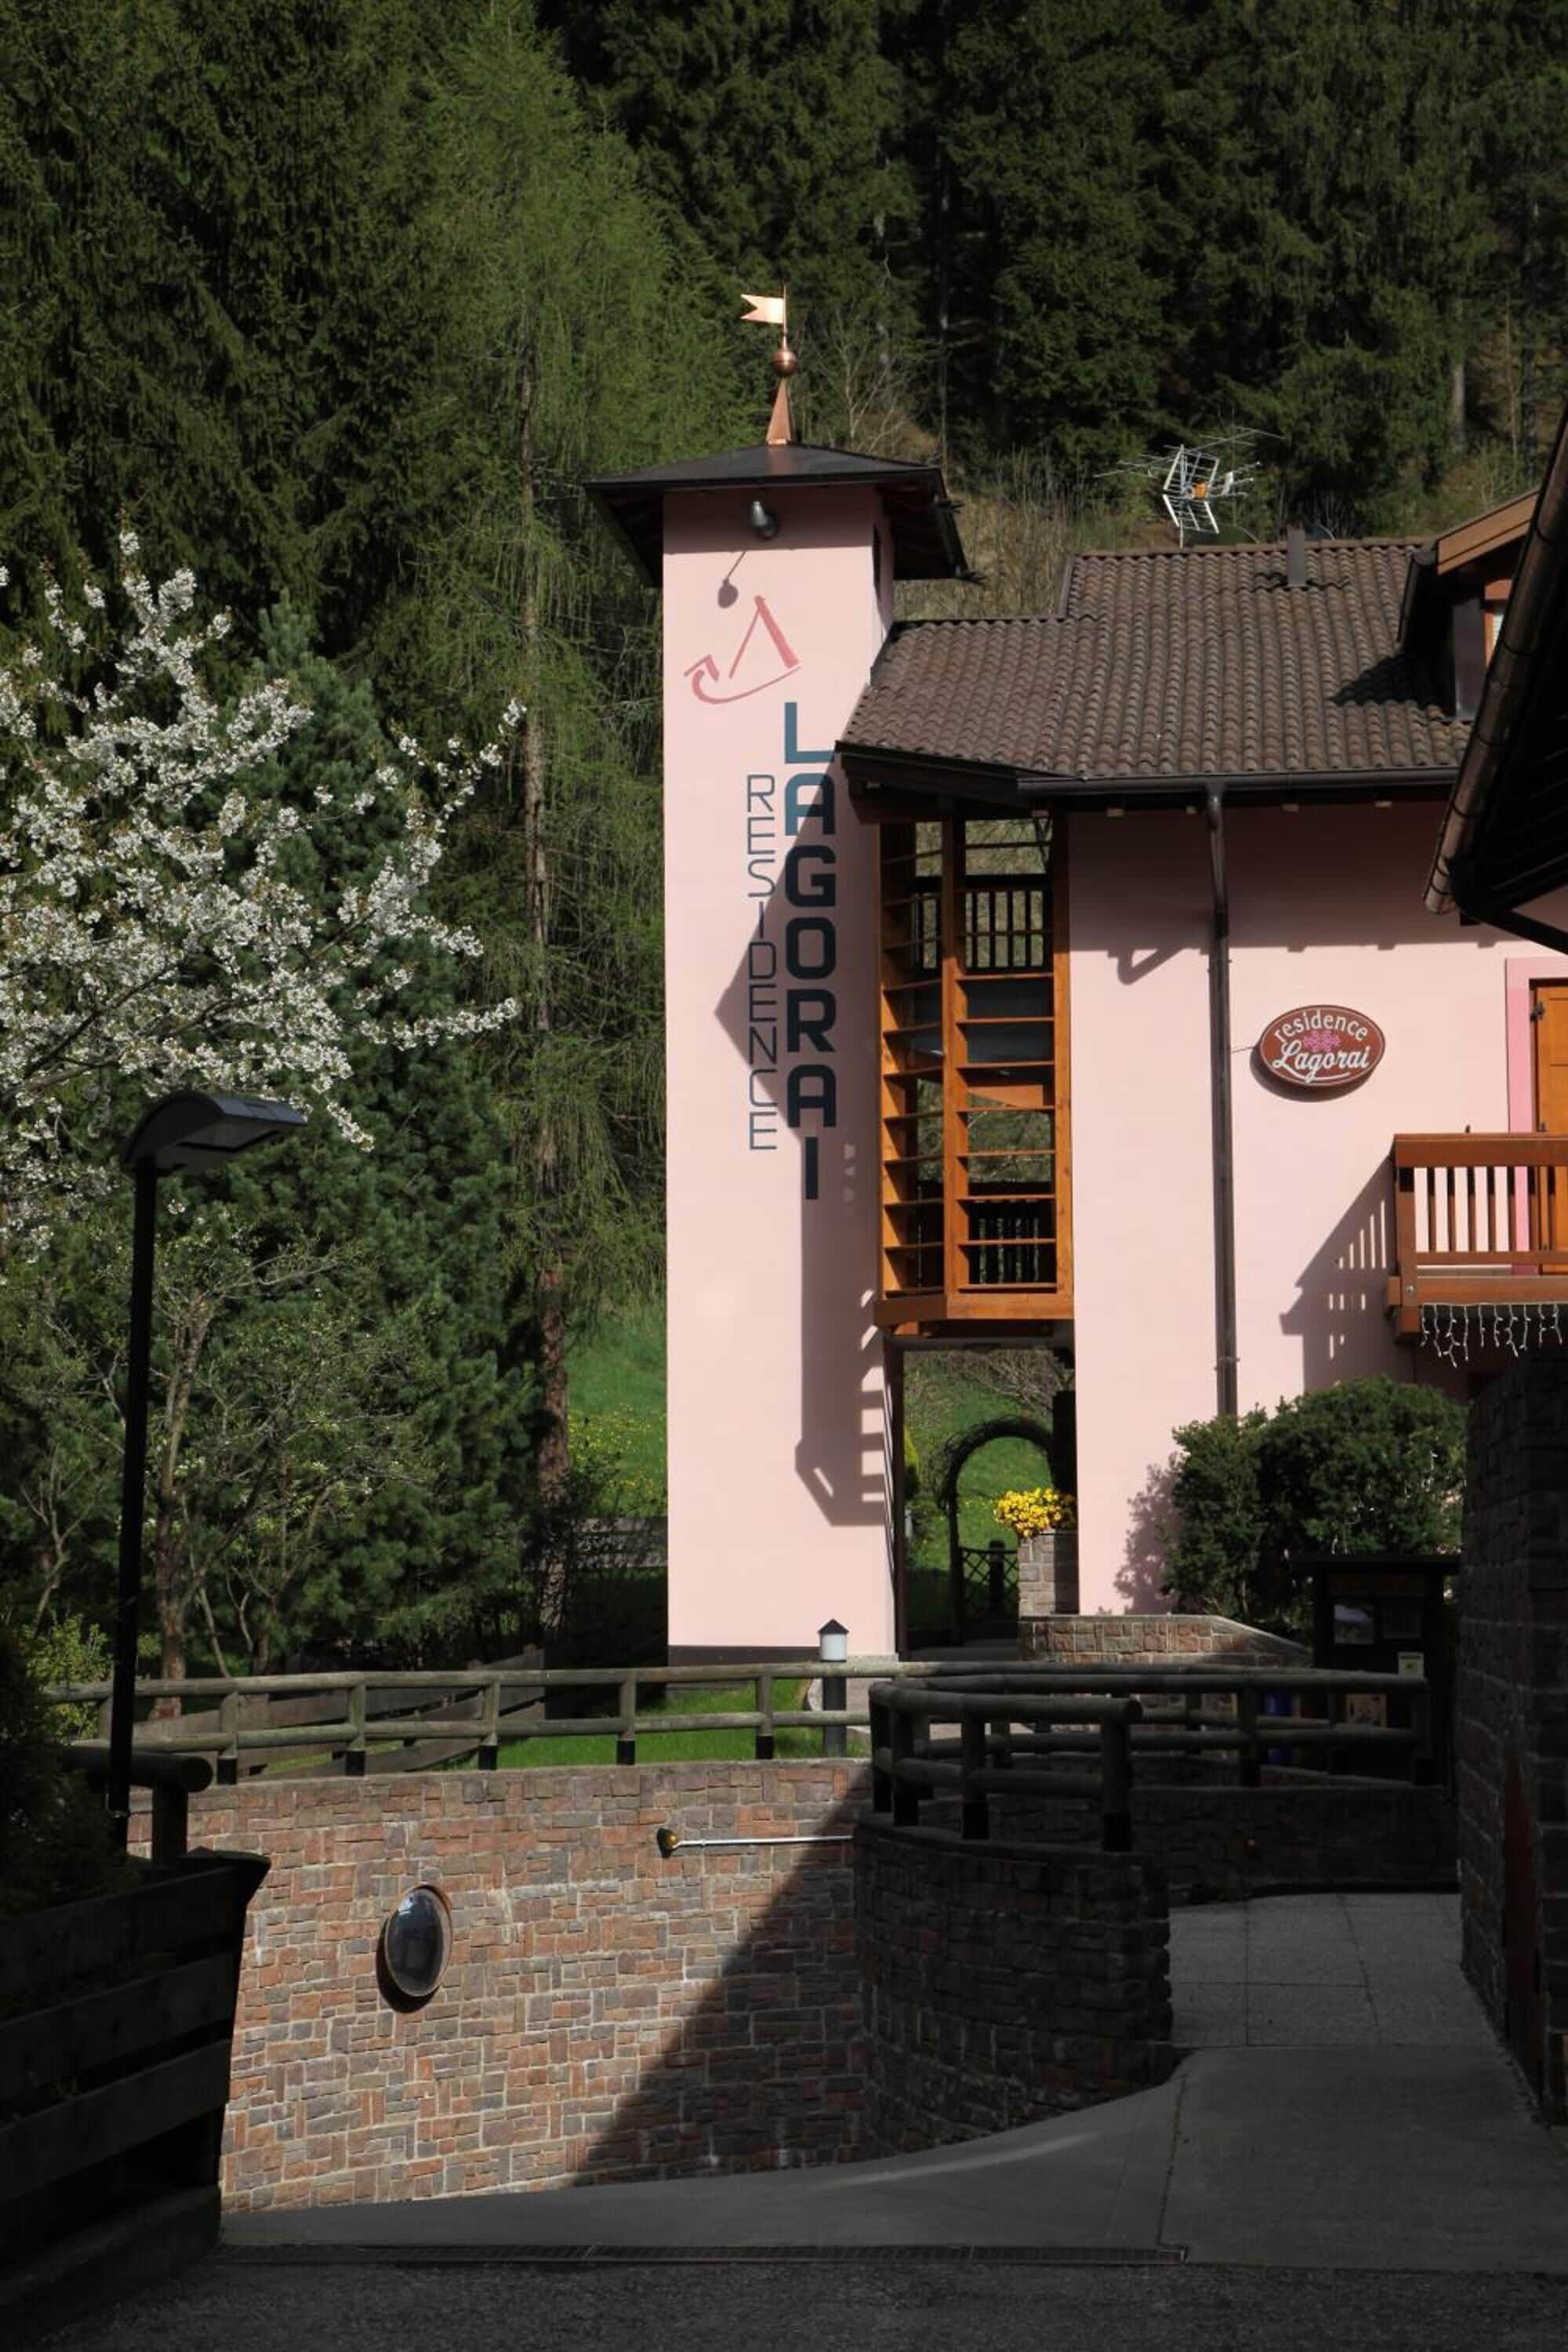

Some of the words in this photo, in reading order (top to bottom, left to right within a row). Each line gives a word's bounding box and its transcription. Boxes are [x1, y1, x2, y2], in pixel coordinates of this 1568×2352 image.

[746, 774, 778, 1150] RESIDENCE
[784, 702, 837, 1200] LAGORAI
[1274, 1009, 1368, 1042] residence
[1272, 1040, 1371, 1083] Lagorai
